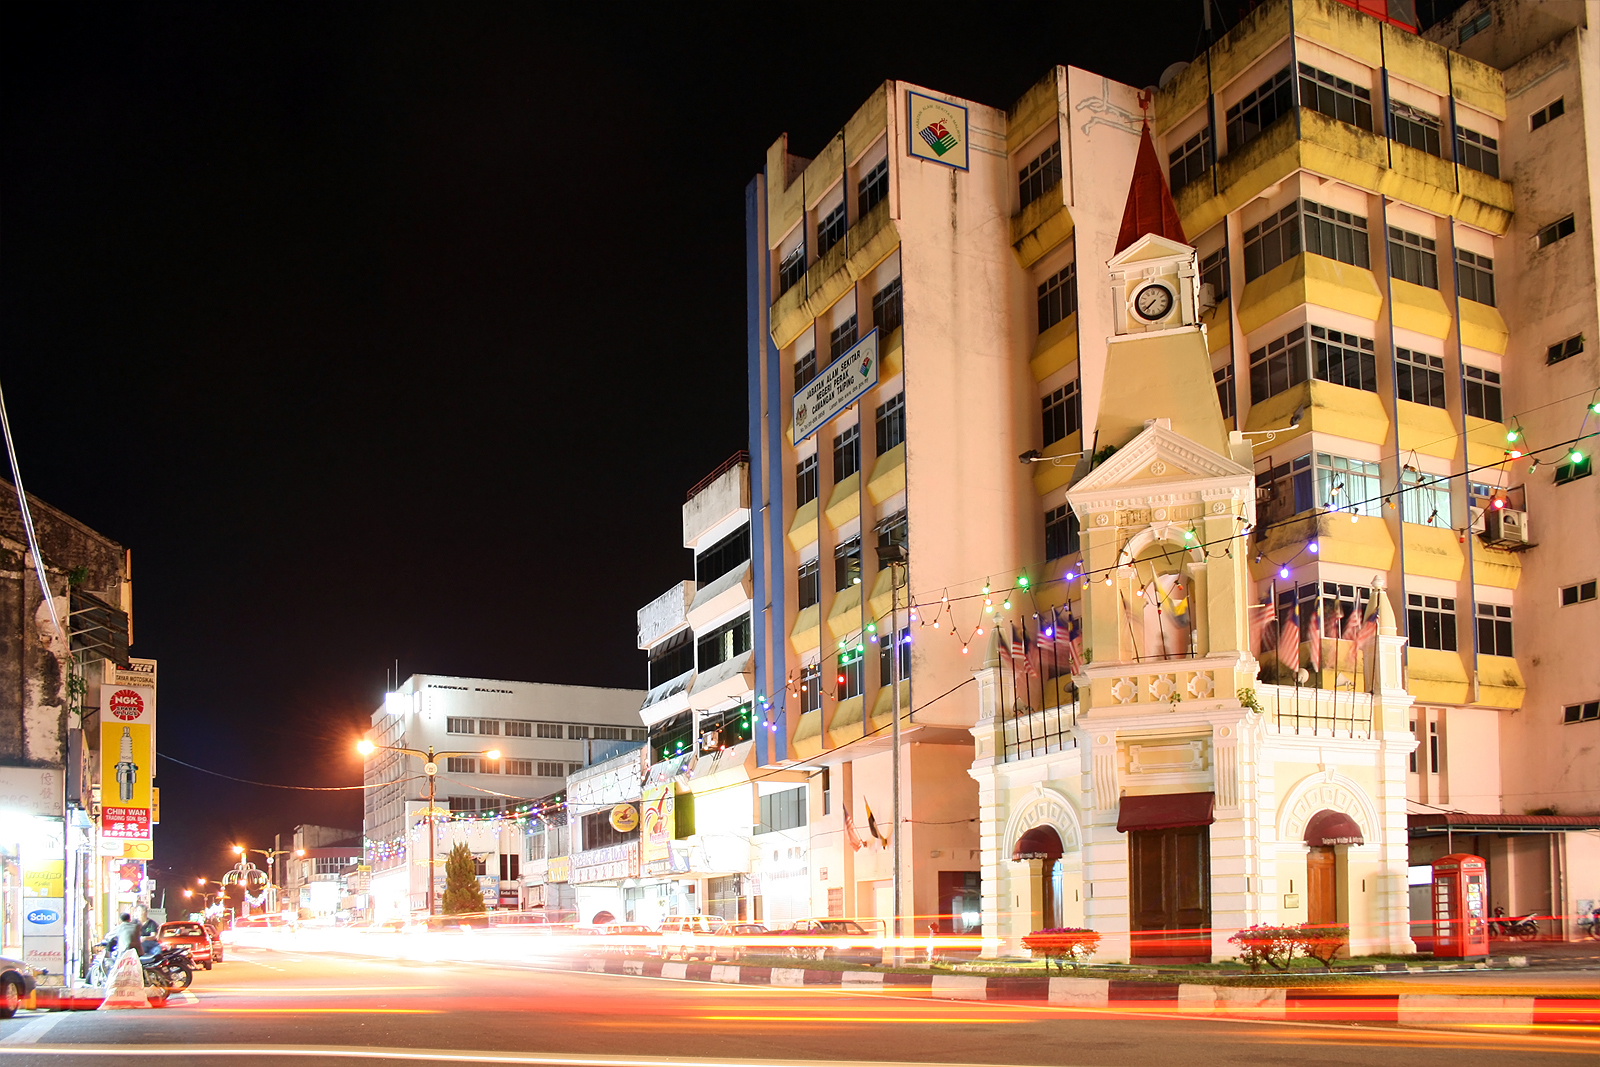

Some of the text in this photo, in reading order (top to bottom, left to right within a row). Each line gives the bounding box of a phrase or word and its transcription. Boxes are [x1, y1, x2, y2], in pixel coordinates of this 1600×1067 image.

[807, 350, 860, 399] JABATAN ALAM SEKITAR
[812, 376, 854, 414] CAWANGAN TAIPING
[816, 370, 849, 401] NEGERI PERAK
[115, 696, 138, 705] NGK
[30, 912, 57, 921] Scholl
[28, 949, 61, 957] Bata
